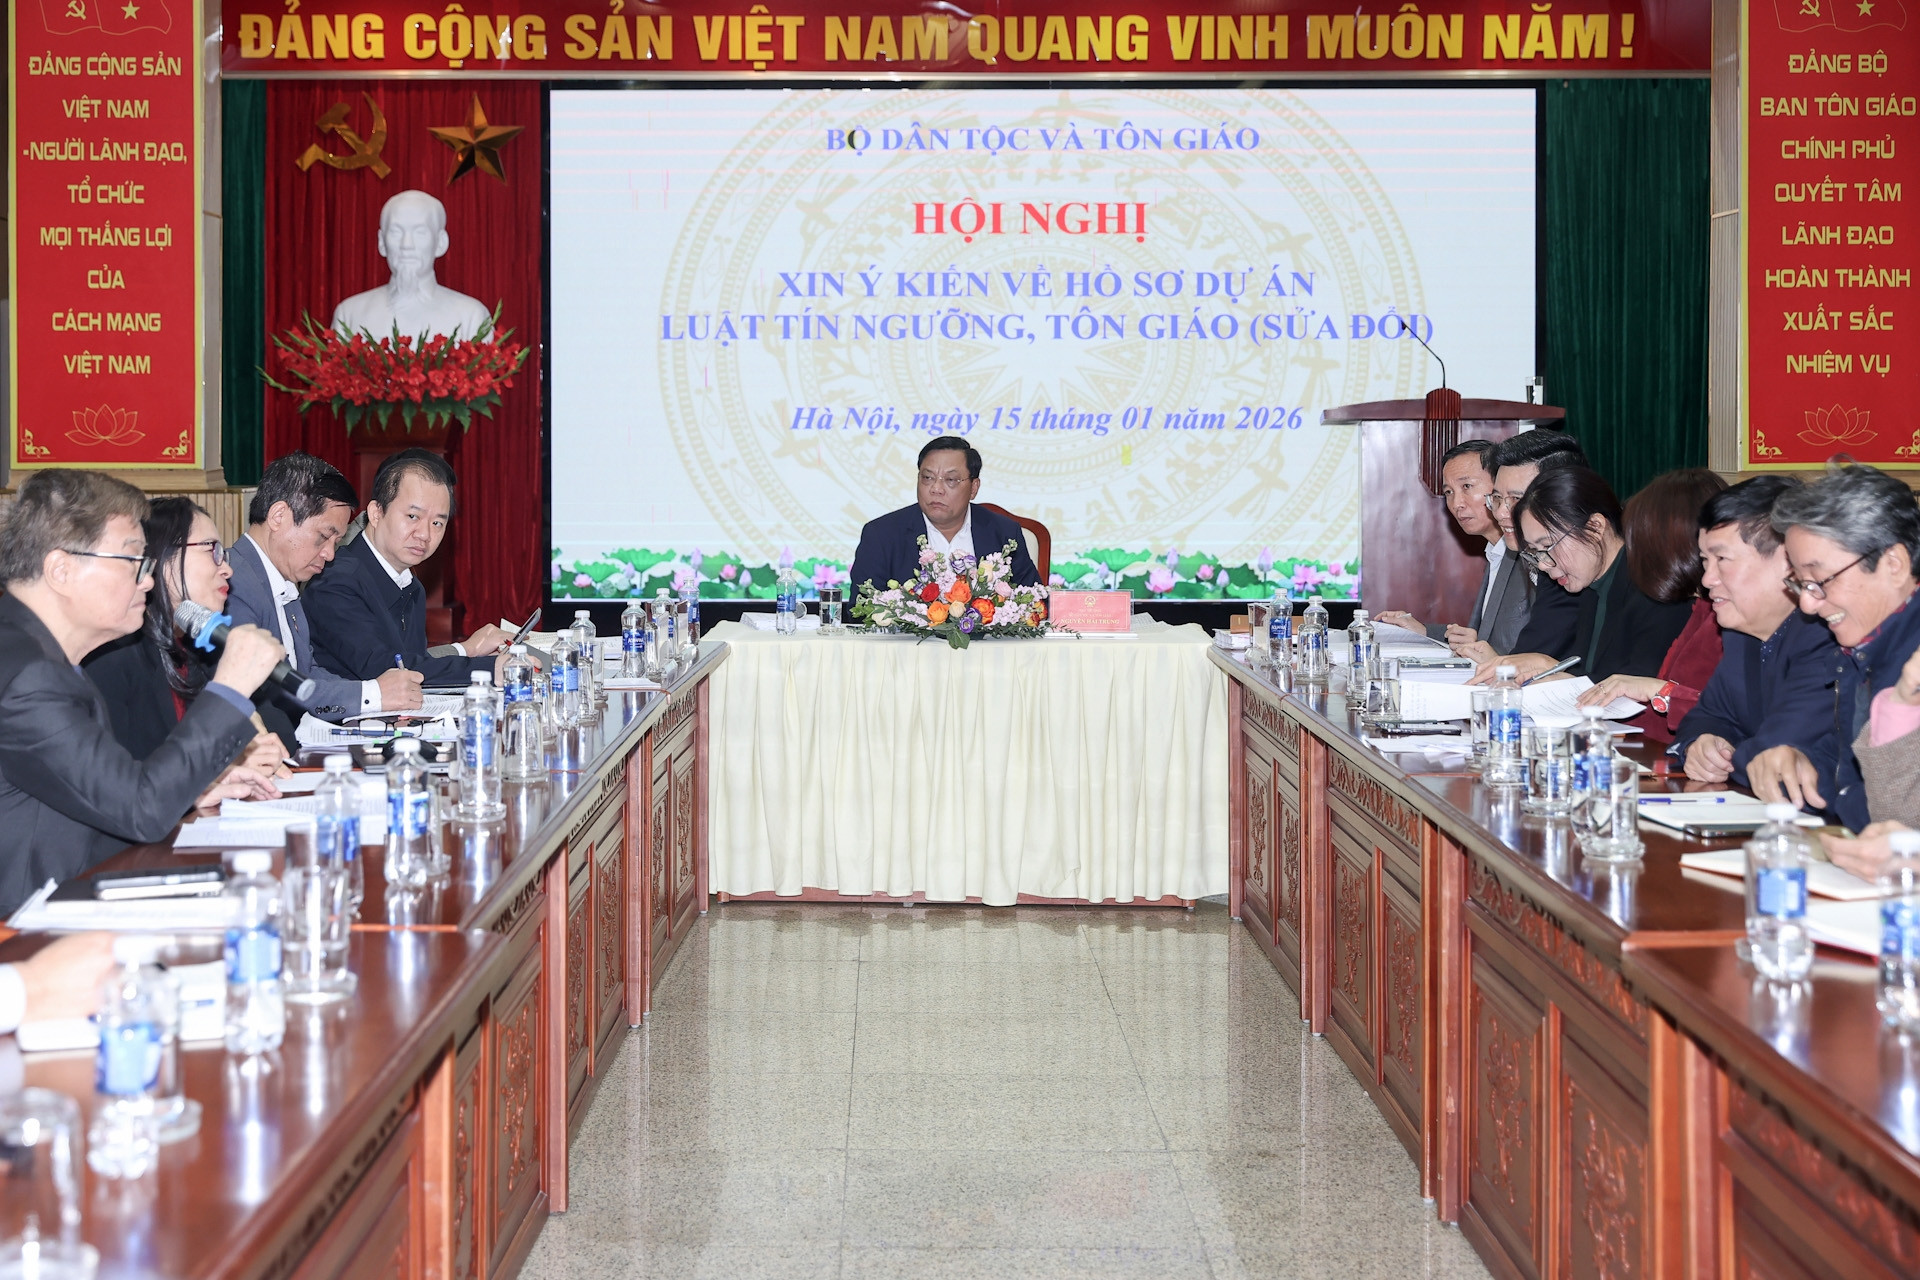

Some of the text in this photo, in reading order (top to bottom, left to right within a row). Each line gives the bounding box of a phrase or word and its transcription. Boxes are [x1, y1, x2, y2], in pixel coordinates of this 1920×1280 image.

[239, 0, 385, 59] ĐẢNG
[403, 4, 547, 67] CỘNG
[564, 0, 673, 60] SẢN
[693, 5, 805, 69] VIỆT
[825, 15, 949, 61] NAM
[967, 15, 1149, 62] QUANG
[1167, 15, 1288, 60] VINH
[1307, 4, 1463, 59] MUÔN
[28, 51, 182, 80] ĐẢNG CỘNG SẢN
[1787, 48, 1888, 78] ĐẢNG BỘ
[62, 94, 149, 123] VIỆT NAM
[1760, 92, 1916, 117] BAN TÔN GIÁO
[23, 137, 188, 166] -NGƯỜI LÃNH ĐẠO,
[826, 121, 1260, 156] BỘ DÂN TỘC VÀ TÔN GIÁO
[1781, 134, 1895, 159] CHÍNH PHỦ
[67, 175, 145, 204] TỔ CHỨC
[1774, 174, 1902, 203] QUYẾT TÂM
[912, 197, 1149, 243] HỘI NGHỊ
[40, 220, 172, 251] MỌI THẮNG LỢI
[1782, 221, 1894, 249] LÃNH ĐẠO
[87, 263, 126, 289] CỦA
[778, 264, 1315, 304] XIN Ý KIẾN VỀ HỒ SƠ DỰ ÁN
[1765, 264, 1911, 288] HOÀN THÀNH
[52, 308, 162, 336] CÁCH MẠNG
[661, 305, 1434, 347] LUẬT TÍN NGƯỠNG, TÔN GIÁO (SỬA ĐỔI)
[1783, 302, 1894, 331] XUẤT SẮC
[63, 350, 151, 378] VIỆT NAM
[1786, 349, 1891, 378] NHIỆM VỤ
[789, 405, 1303, 437] Hà Nội, ngày 15 tháng 01 năm 2026
